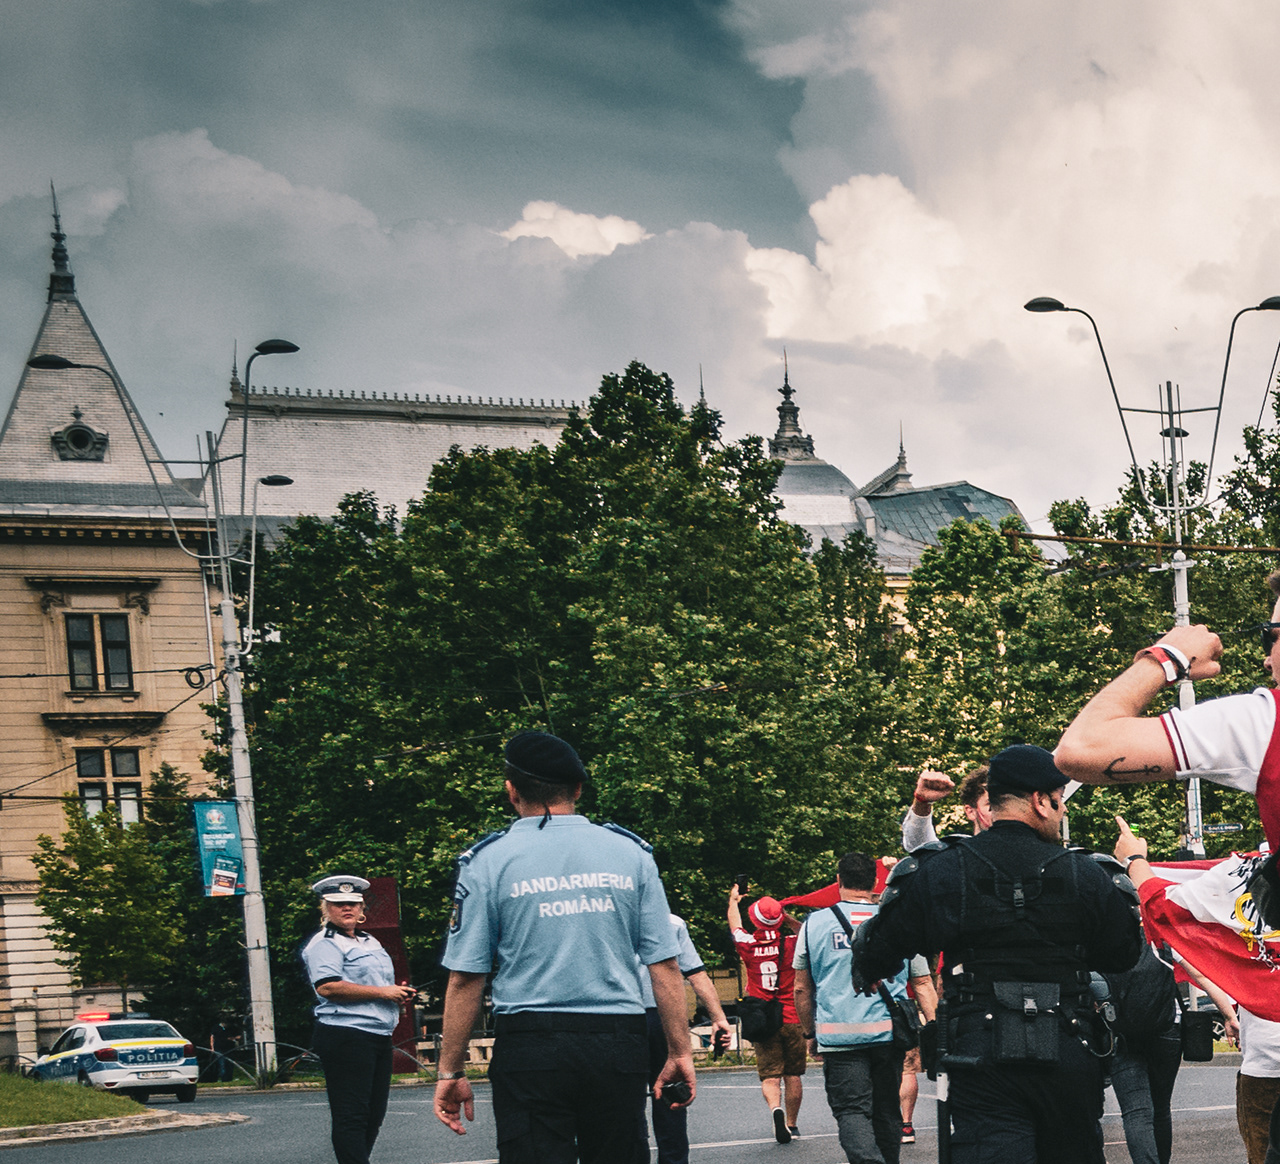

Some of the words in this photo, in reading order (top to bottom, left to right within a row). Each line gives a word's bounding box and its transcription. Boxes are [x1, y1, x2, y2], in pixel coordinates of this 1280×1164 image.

[510, 872, 634, 898] JANDARMERIA
[540, 894, 616, 918] ROMÂNĂ
[754, 946, 780, 957] ALABA
